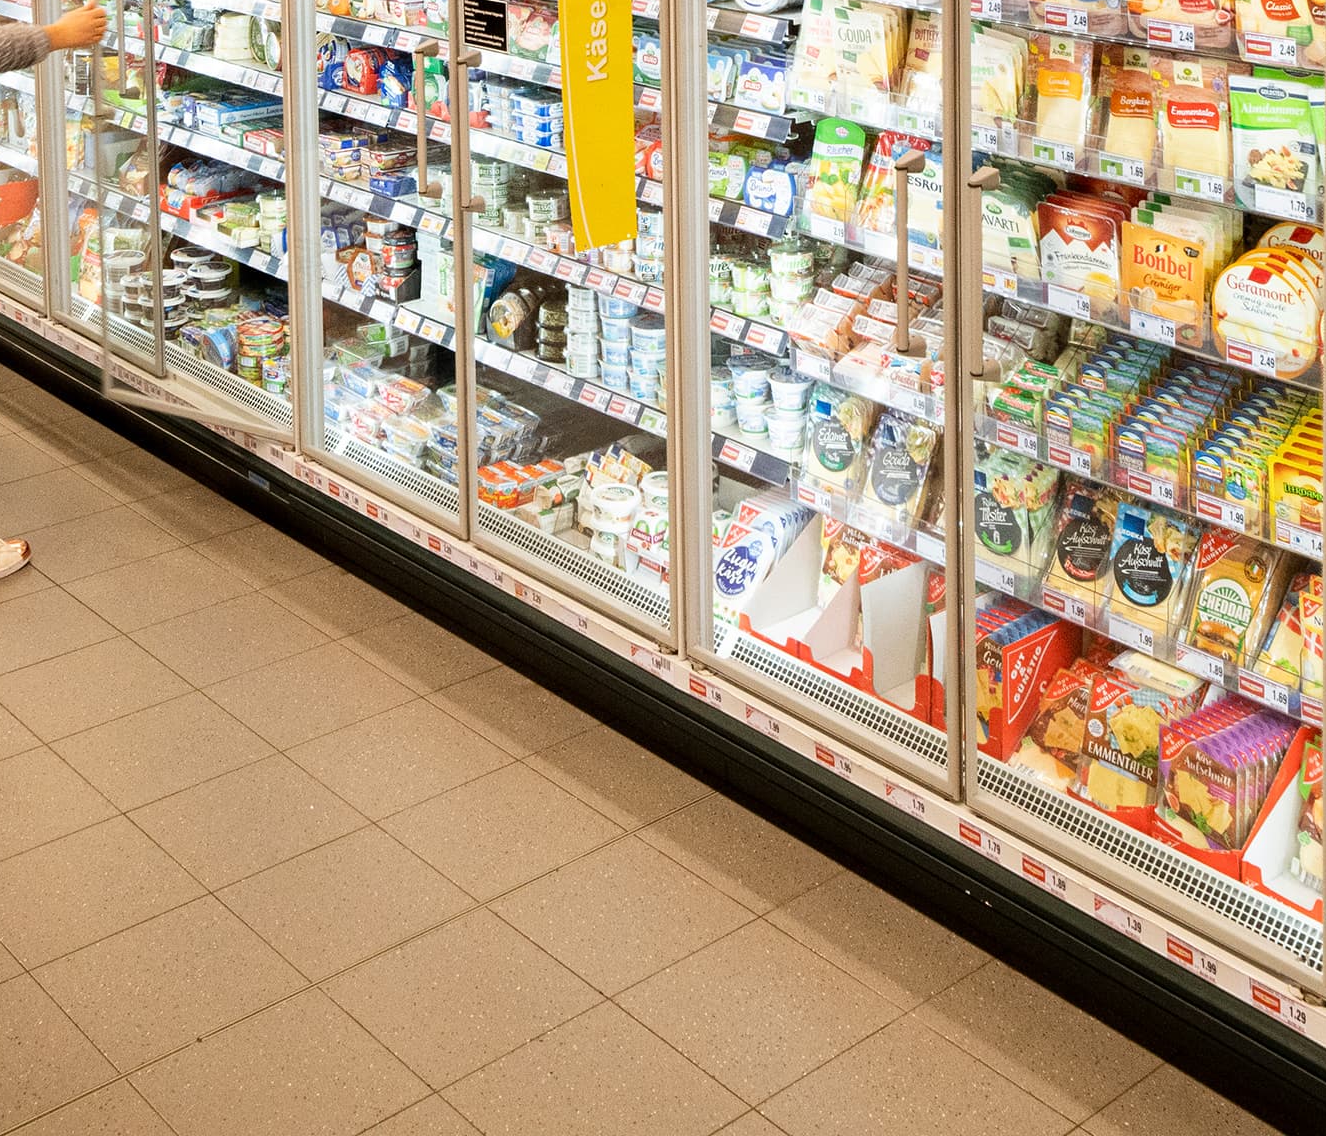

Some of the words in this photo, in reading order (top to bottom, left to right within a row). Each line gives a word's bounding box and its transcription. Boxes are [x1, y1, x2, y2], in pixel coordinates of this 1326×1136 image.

[587, 0, 609, 82] Käse
[838, 28, 872, 44] GOUDA
[1171, 105, 1215, 118] Emmentaler
[1133, 244, 1193, 282] Bonbel
[1226, 274, 1295, 305] Géramont
[818, 427, 848, 442] Edamer
[883, 452, 910, 466] Gouda
[1198, 591, 1252, 621] CHEDDAR
[1088, 741, 1153, 782] EMMENTALER
